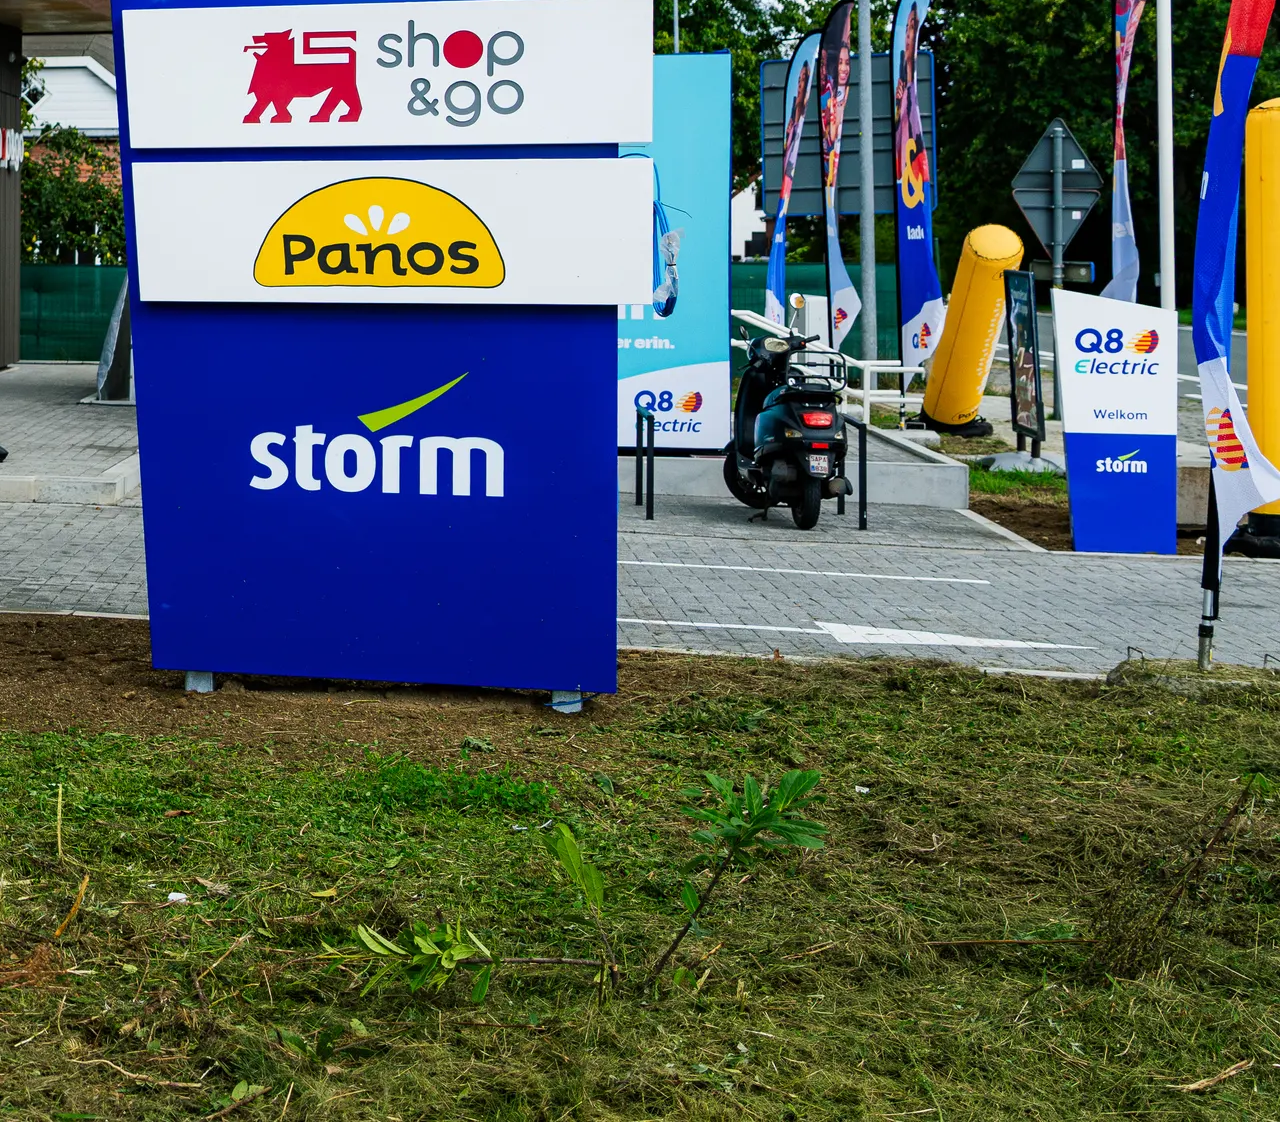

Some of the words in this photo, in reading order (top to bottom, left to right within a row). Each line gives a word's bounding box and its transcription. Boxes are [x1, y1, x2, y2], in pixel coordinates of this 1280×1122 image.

[376, 19, 525, 77] shop
[407, 78, 525, 127] &go
[283, 234, 480, 276] Panos
[634, 336, 676, 349] erin.
[1075, 328, 1124, 353] Q8
[1074, 358, 1160, 375] Electric
[634, 390, 673, 412] Q8
[635, 418, 702, 433] ectric
[1093, 408, 1148, 421] Welkom
[250, 424, 505, 498] storm
[1096, 456, 1148, 474] storm
